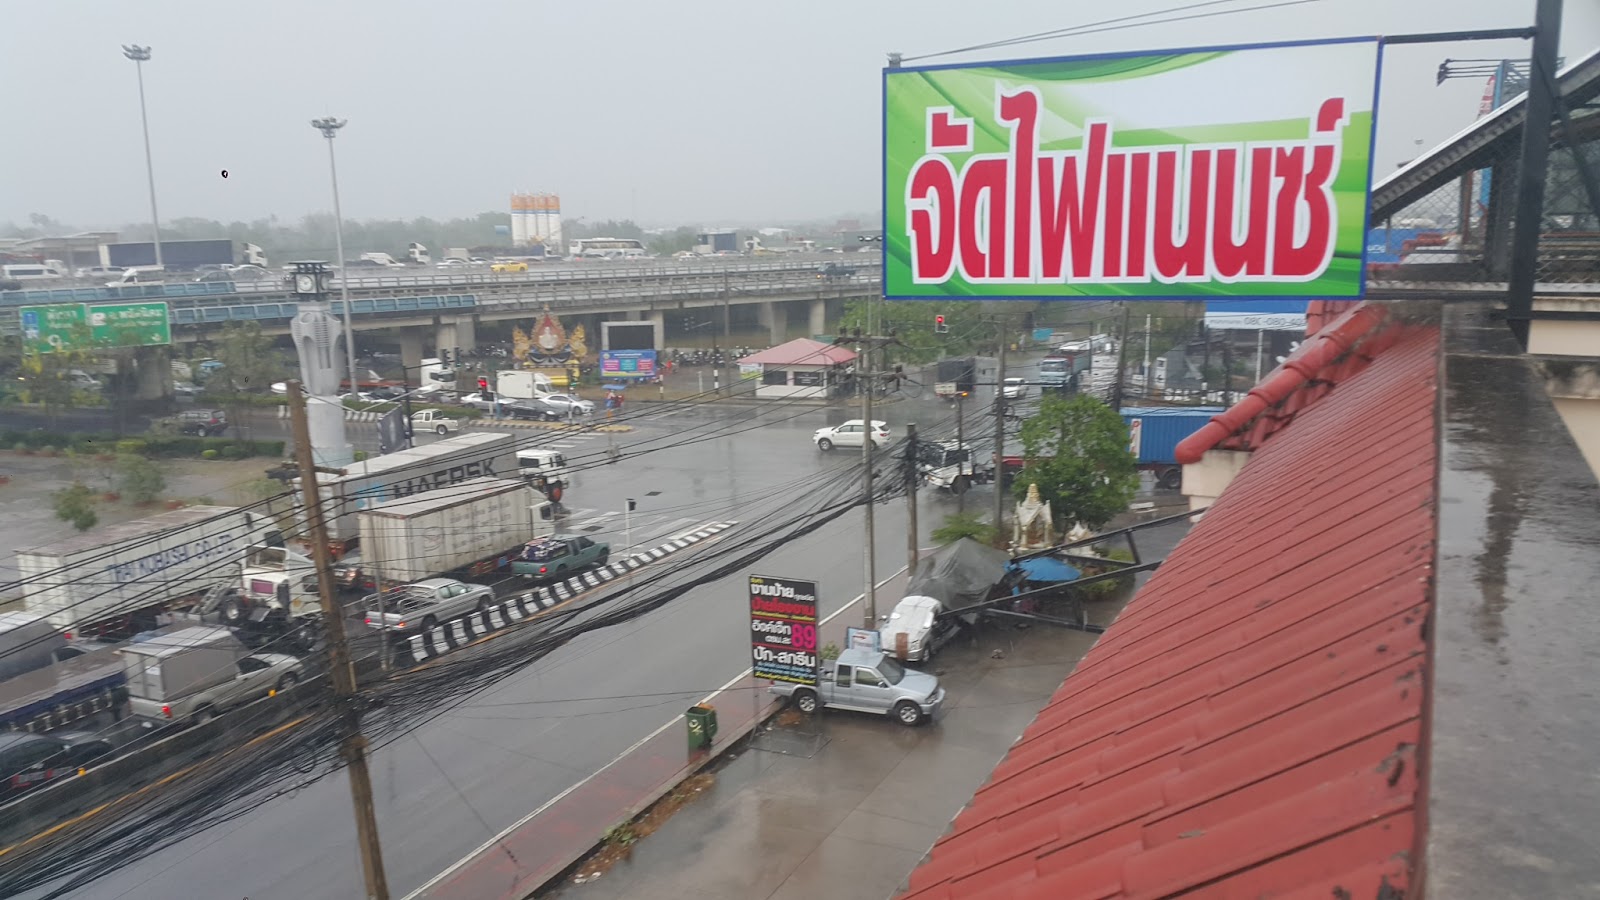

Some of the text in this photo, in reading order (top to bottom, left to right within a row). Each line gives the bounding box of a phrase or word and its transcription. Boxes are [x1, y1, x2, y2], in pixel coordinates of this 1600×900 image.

[907, 87, 1346, 280] จัดไฟแนนซ์
[394, 457, 498, 499] MAERSK
[791, 623, 816, 649] 89
